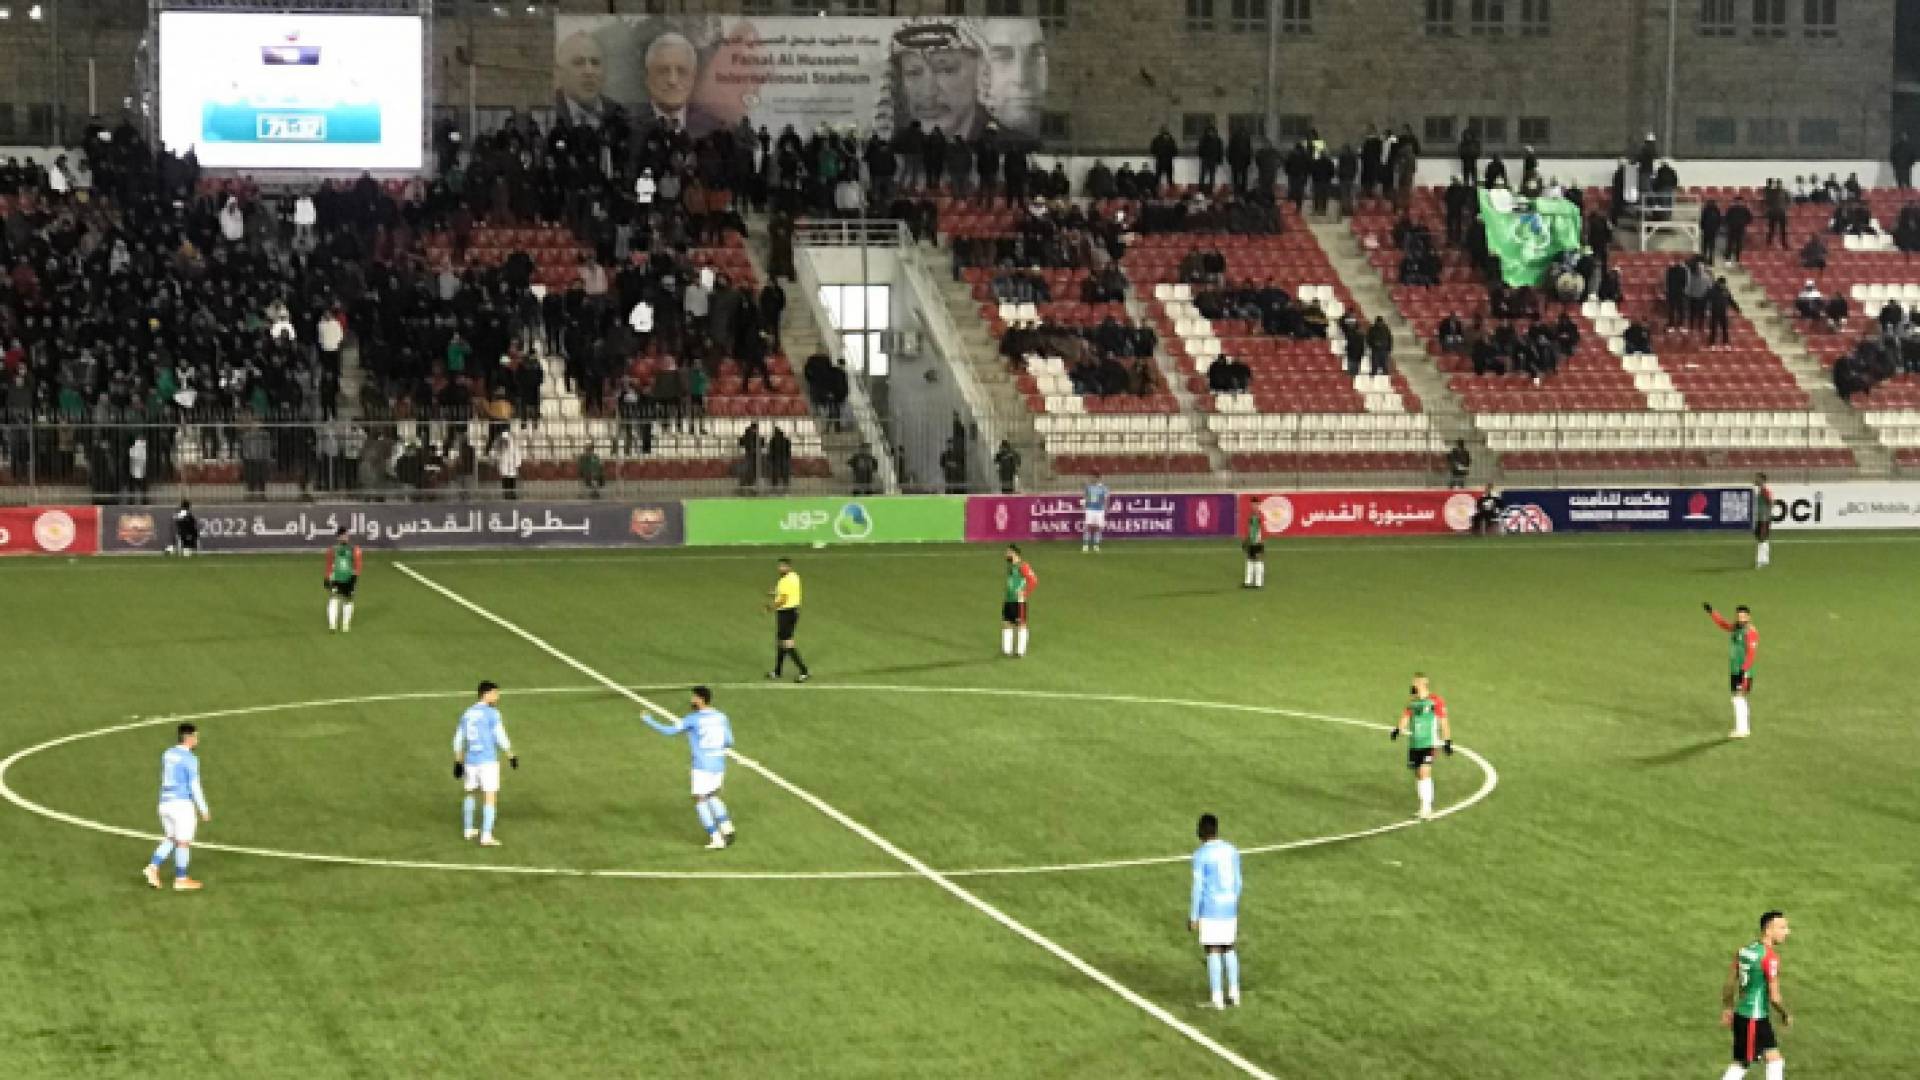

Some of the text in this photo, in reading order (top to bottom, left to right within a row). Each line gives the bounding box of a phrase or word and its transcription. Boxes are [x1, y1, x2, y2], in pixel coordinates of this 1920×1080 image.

[715, 72, 870, 85] International Stadium
[1126, 499, 1175, 516] بنك
[1302, 501, 1435, 528] سنيورة القدس
[199, 517, 247, 536] 2022
[385, 510, 482, 540] القدس
[488, 509, 590, 538] بطولة
[1030, 520, 1070, 533] BANK
